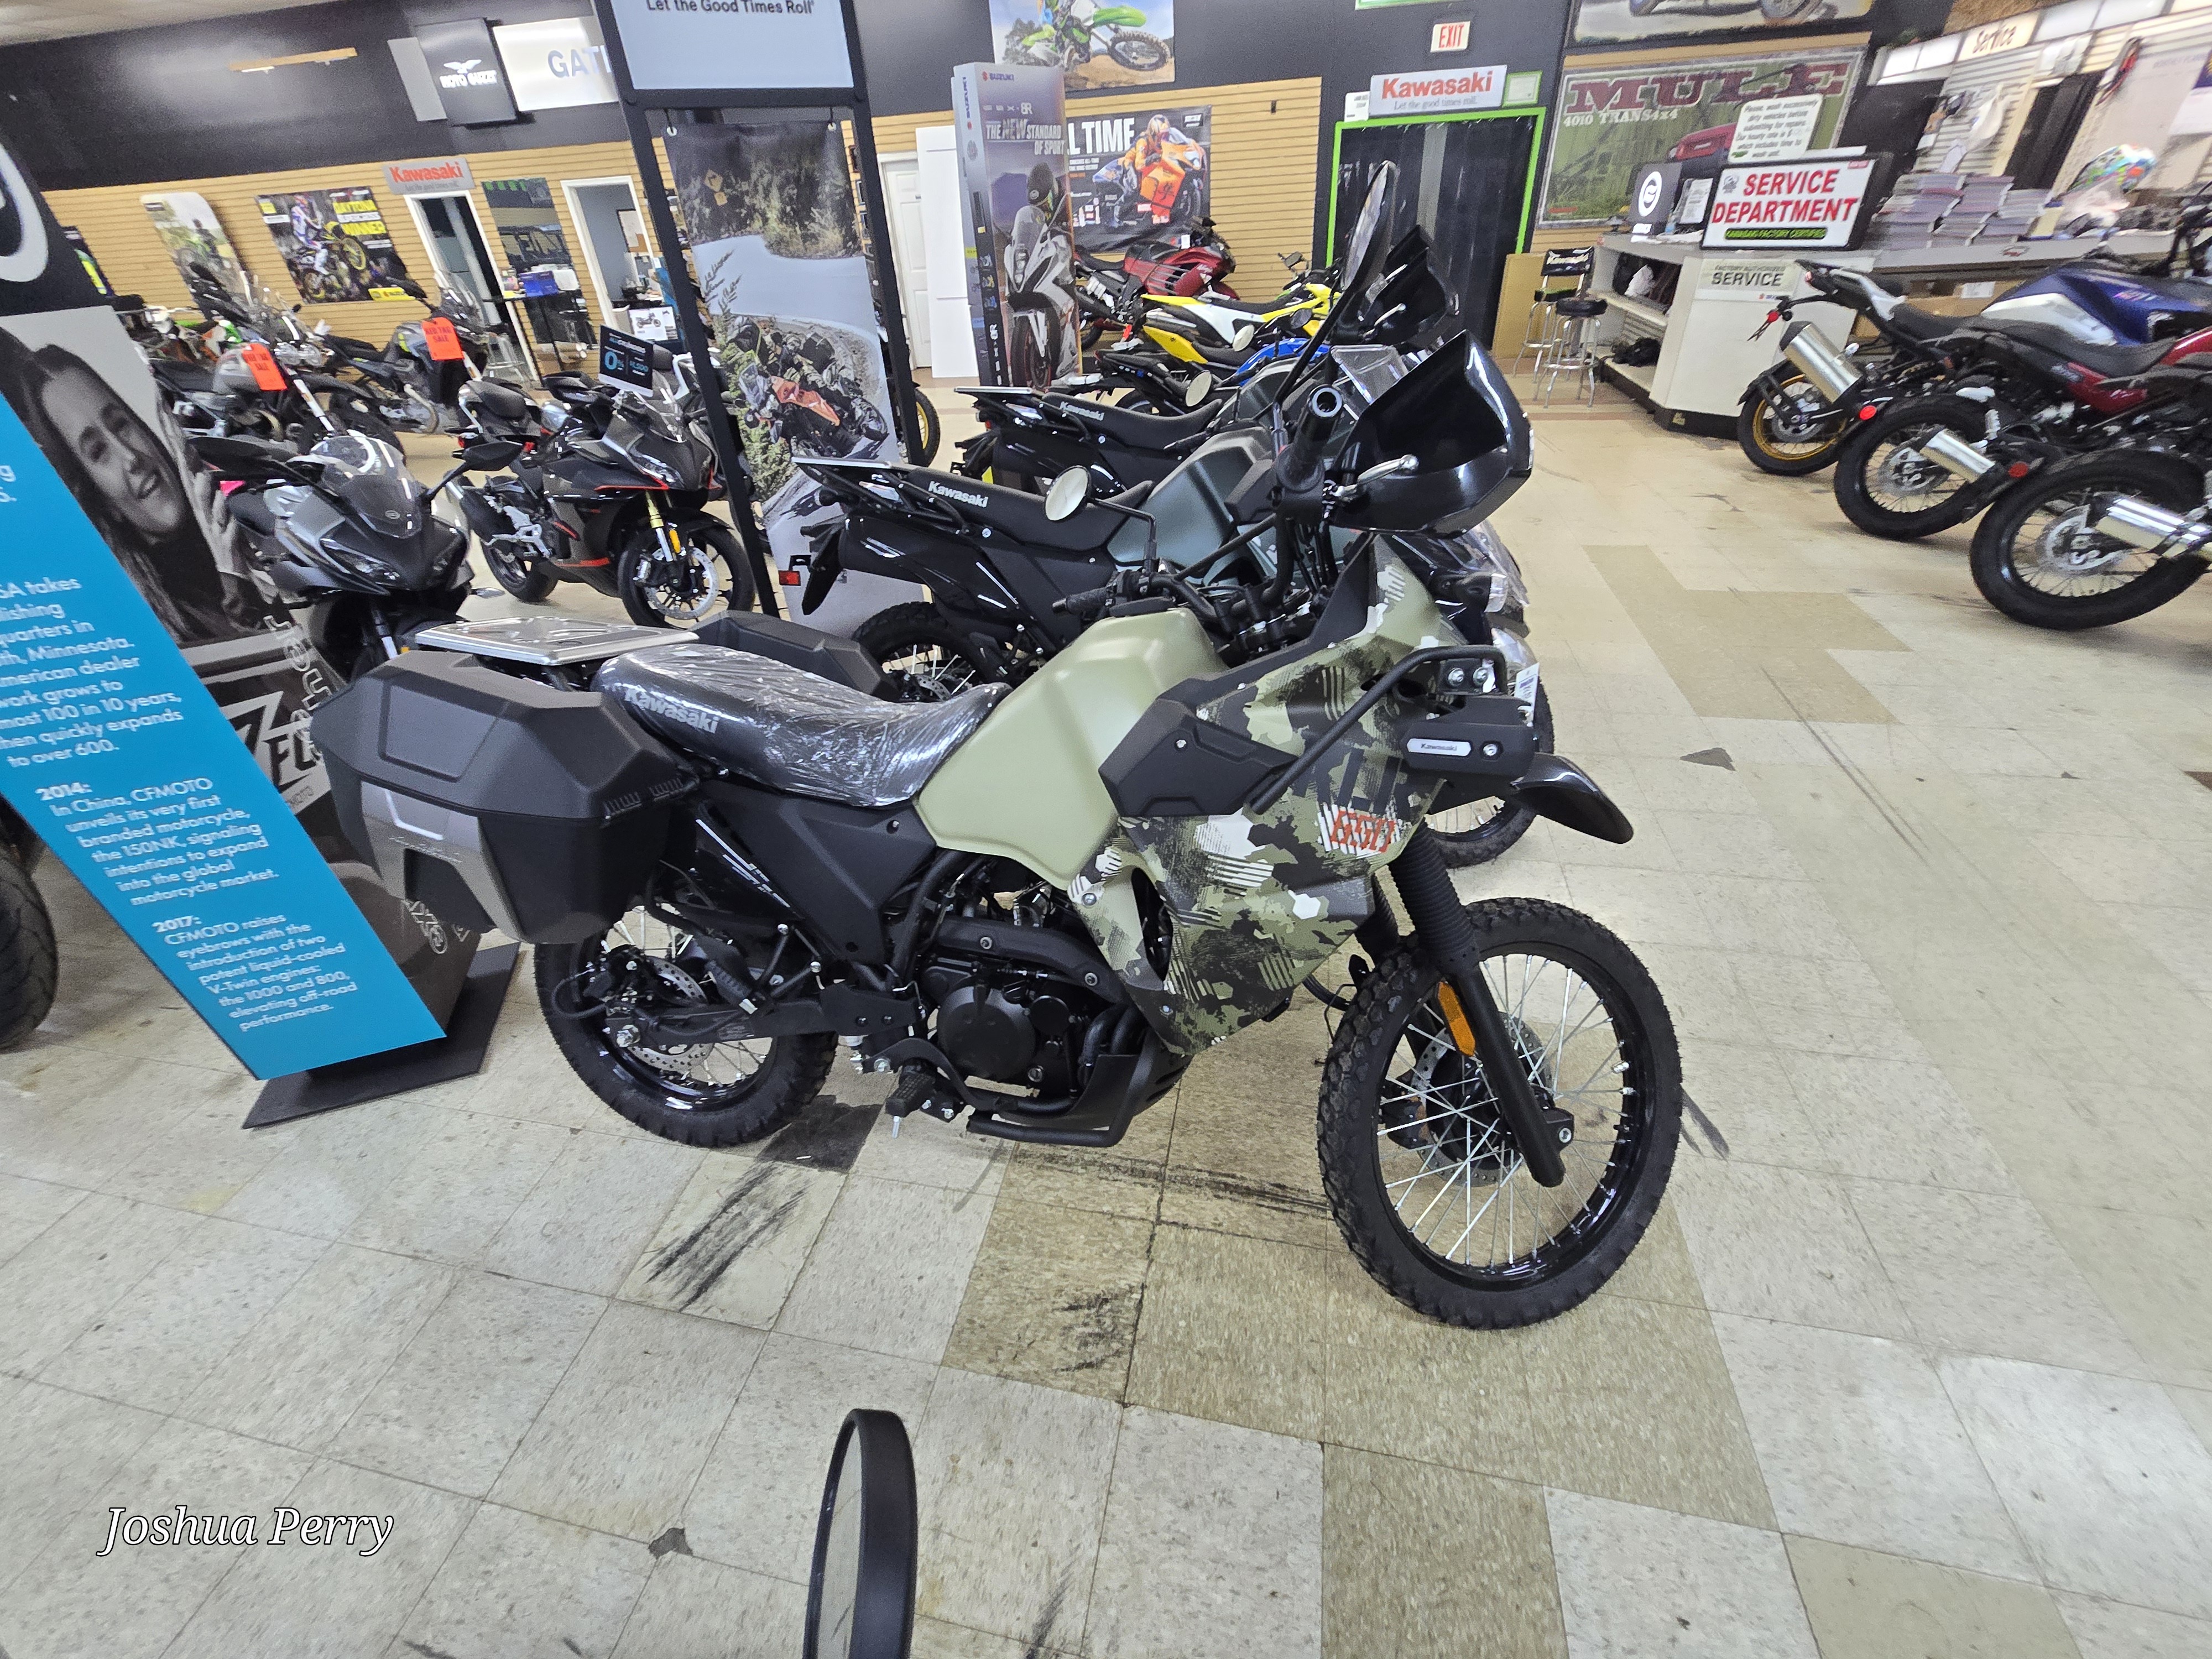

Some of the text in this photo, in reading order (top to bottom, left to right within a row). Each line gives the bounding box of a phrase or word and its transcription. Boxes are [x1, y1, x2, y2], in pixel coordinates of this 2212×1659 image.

[646, 0, 671, 11] Let
[675, 0, 697, 11] the
[701, 0, 738, 12] Good
[744, 0, 782, 13] Times
[1438, 24, 1464, 49] EXIT
[440, 70, 497, 88] MOTO GUZZI
[989, 73, 1014, 81] SUZUKI
[1381, 70, 1493, 100] Kawasaki
[1566, 63, 1849, 113] MULE
[986, 118, 1062, 140] THE NEW STANDARD
[1563, 114, 1593, 127] 4010
[1035, 140, 1065, 155] OF SPORT
[1067, 123, 1081, 155] L
[389, 161, 463, 183] Kawasaki
[1743, 168, 1840, 197] SERVICE
[1712, 196, 1861, 224] DEPARTMENT
[1712, 272, 1783, 286] SERVICE
[928, 481, 989, 508] Kawasaki
[24, 576, 82, 594] takes
[71, 619, 95, 633] in
[79, 655, 140, 675] dealer
[42, 684, 101, 705] grows
[100, 680, 123, 692] to
[41, 705, 80, 721] 100
[79, 703, 102, 716] in
[99, 697, 124, 712] 10
[624, 688, 719, 734] Kawasaki
[38, 722, 103, 745] quickly
[106, 708, 184, 732] expands
[6, 739, 120, 768] to over 600.
[35, 782, 93, 801] 2014:
[49, 804, 73, 817] In
[130, 778, 213, 801] CFMOTO
[65, 795, 221, 832] unveils its very first
[76, 823, 155, 848] branded
[91, 850, 123, 863] the
[186, 824, 262, 846] signaling
[1329, 810, 1396, 853] 650
[103, 836, 269, 878] intentions to expand
[115, 859, 236, 891] into the global
[130, 868, 279, 905] motorcycle market.
[152, 915, 202, 932] 2017:
[164, 914, 286, 945] CFMOTO raises
[176, 923, 312, 959] eyebrows with the
[185, 935, 327, 971] introduction of two
[198, 942, 347, 985] potent liquid-cooled
[205, 979, 259, 994] V-Twin
[218, 995, 245, 1006] the
[243, 985, 284, 1001] 1000
[285, 977, 315, 992] and
[228, 981, 358, 1018] elevating off-road
[238, 1002, 335, 1032] performance.
